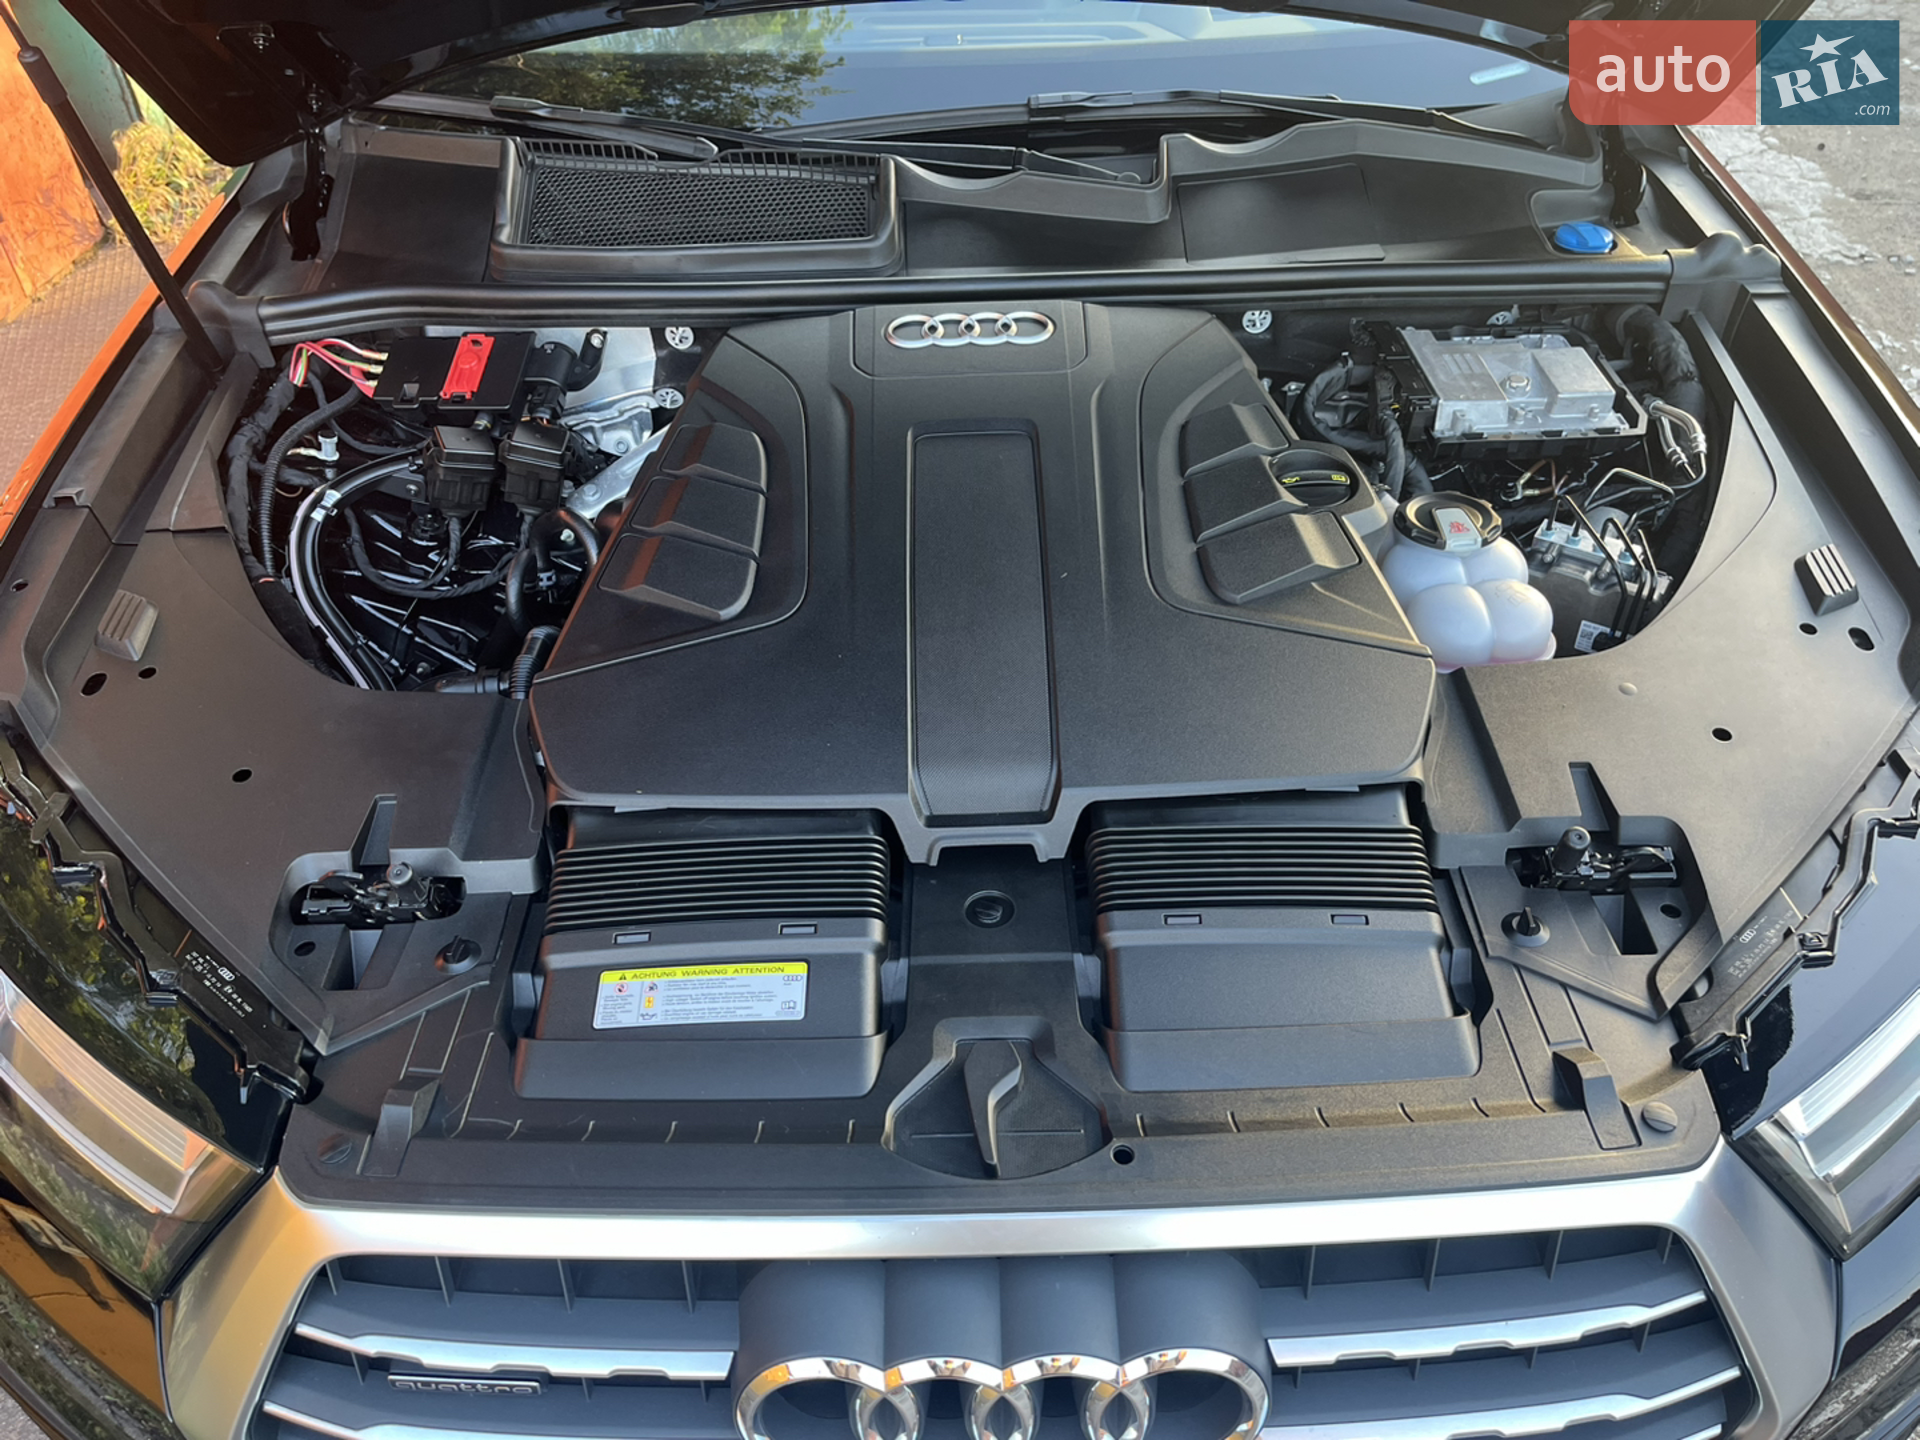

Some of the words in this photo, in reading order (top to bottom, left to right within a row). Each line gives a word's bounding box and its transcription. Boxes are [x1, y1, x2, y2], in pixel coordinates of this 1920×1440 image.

[631, 971, 677, 980] ACHTUNG
[681, 968, 728, 977] WARNING
[732, 966, 785, 974] ATTENTION
[395, 1380, 533, 1394] quattro
